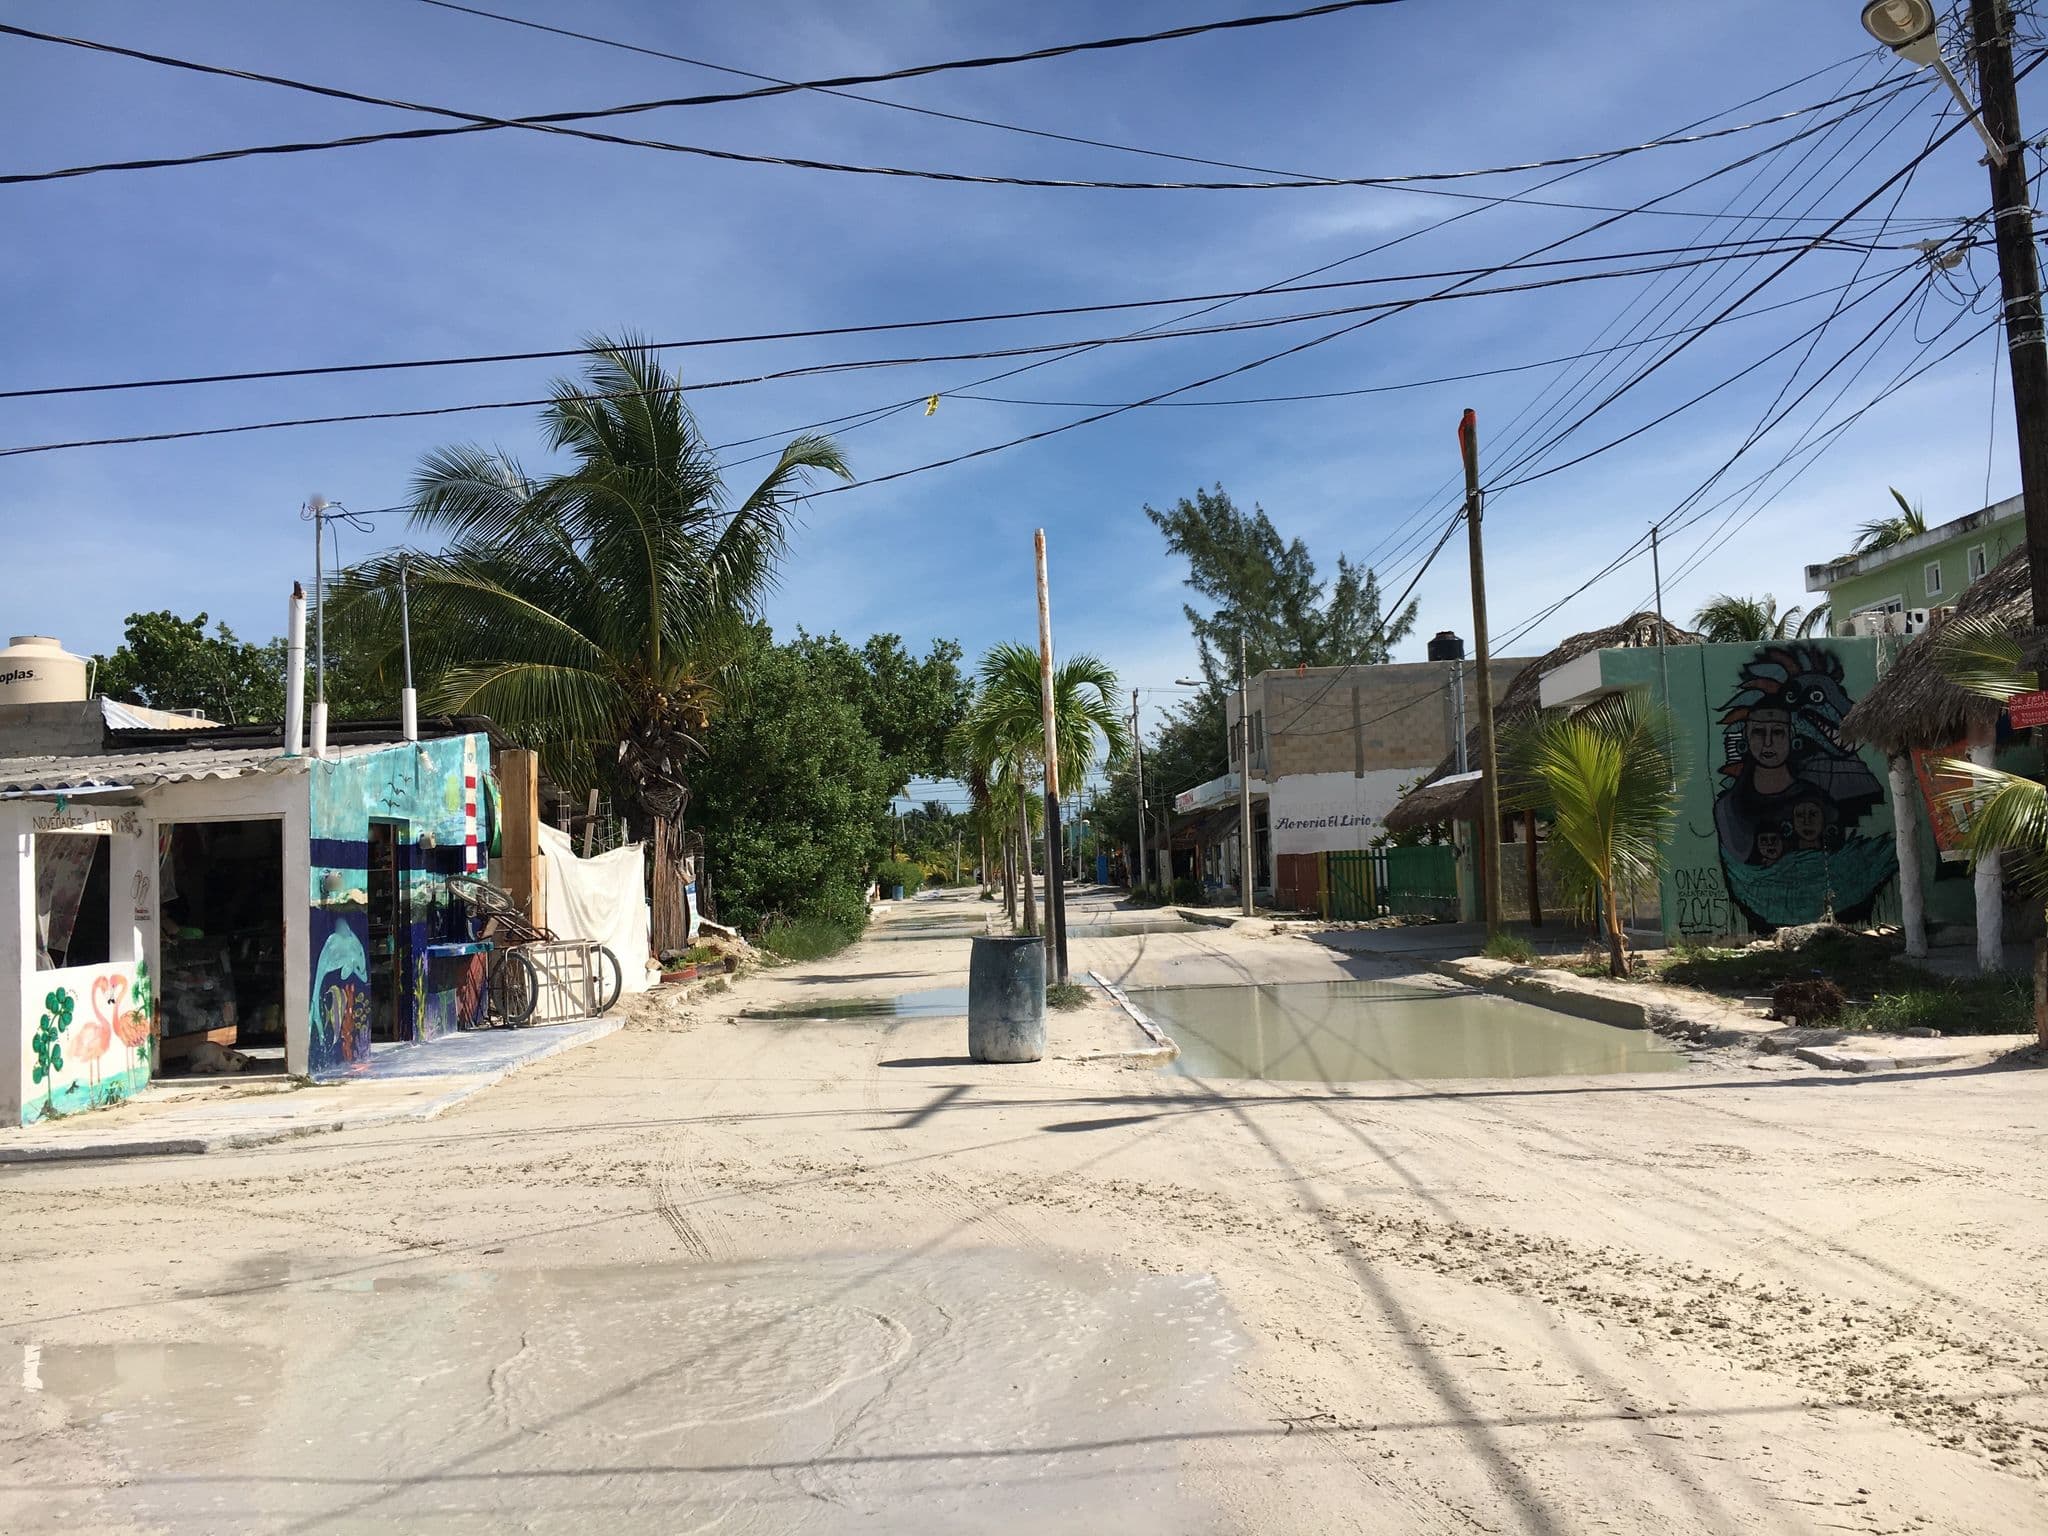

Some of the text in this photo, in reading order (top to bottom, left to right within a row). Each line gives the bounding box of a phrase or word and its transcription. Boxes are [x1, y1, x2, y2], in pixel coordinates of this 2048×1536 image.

[32, 814, 83, 830] NOVEDADES
[1328, 816, 1338, 827] El
[1340, 815, 1371, 826] Lirio
[1675, 868, 1719, 890] ONAS
[1677, 897, 1728, 928] 2015
